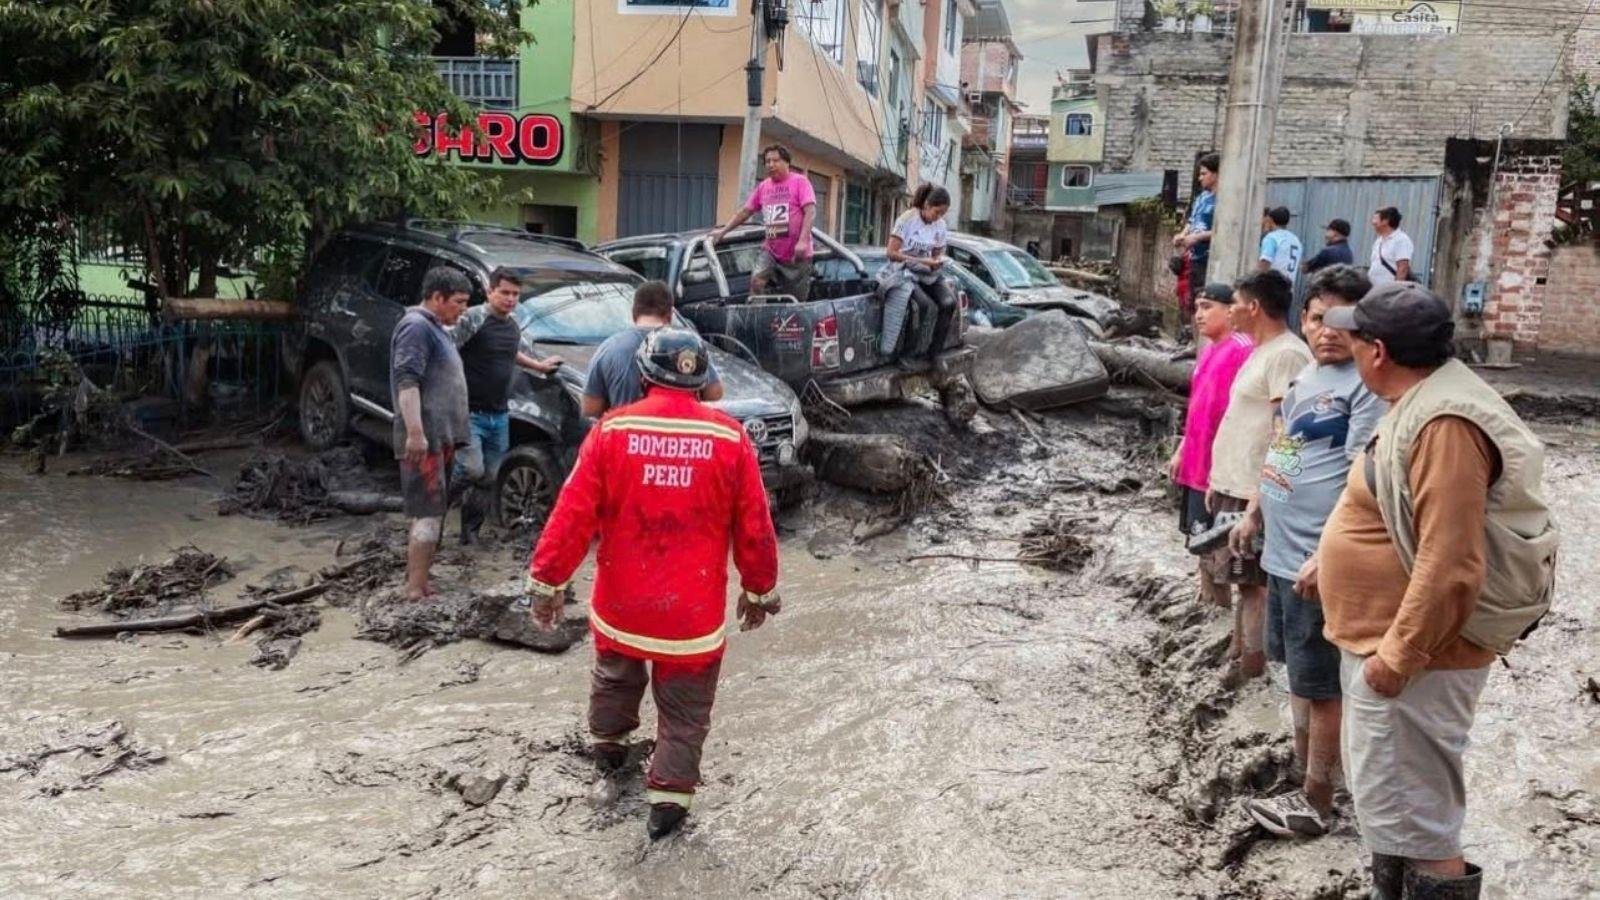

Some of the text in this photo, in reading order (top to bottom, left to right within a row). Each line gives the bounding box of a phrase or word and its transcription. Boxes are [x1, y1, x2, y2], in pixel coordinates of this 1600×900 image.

[1391, 11, 1440, 23] Casita
[1287, 244, 1299, 272] 5
[627, 433, 714, 460] BOMBERO
